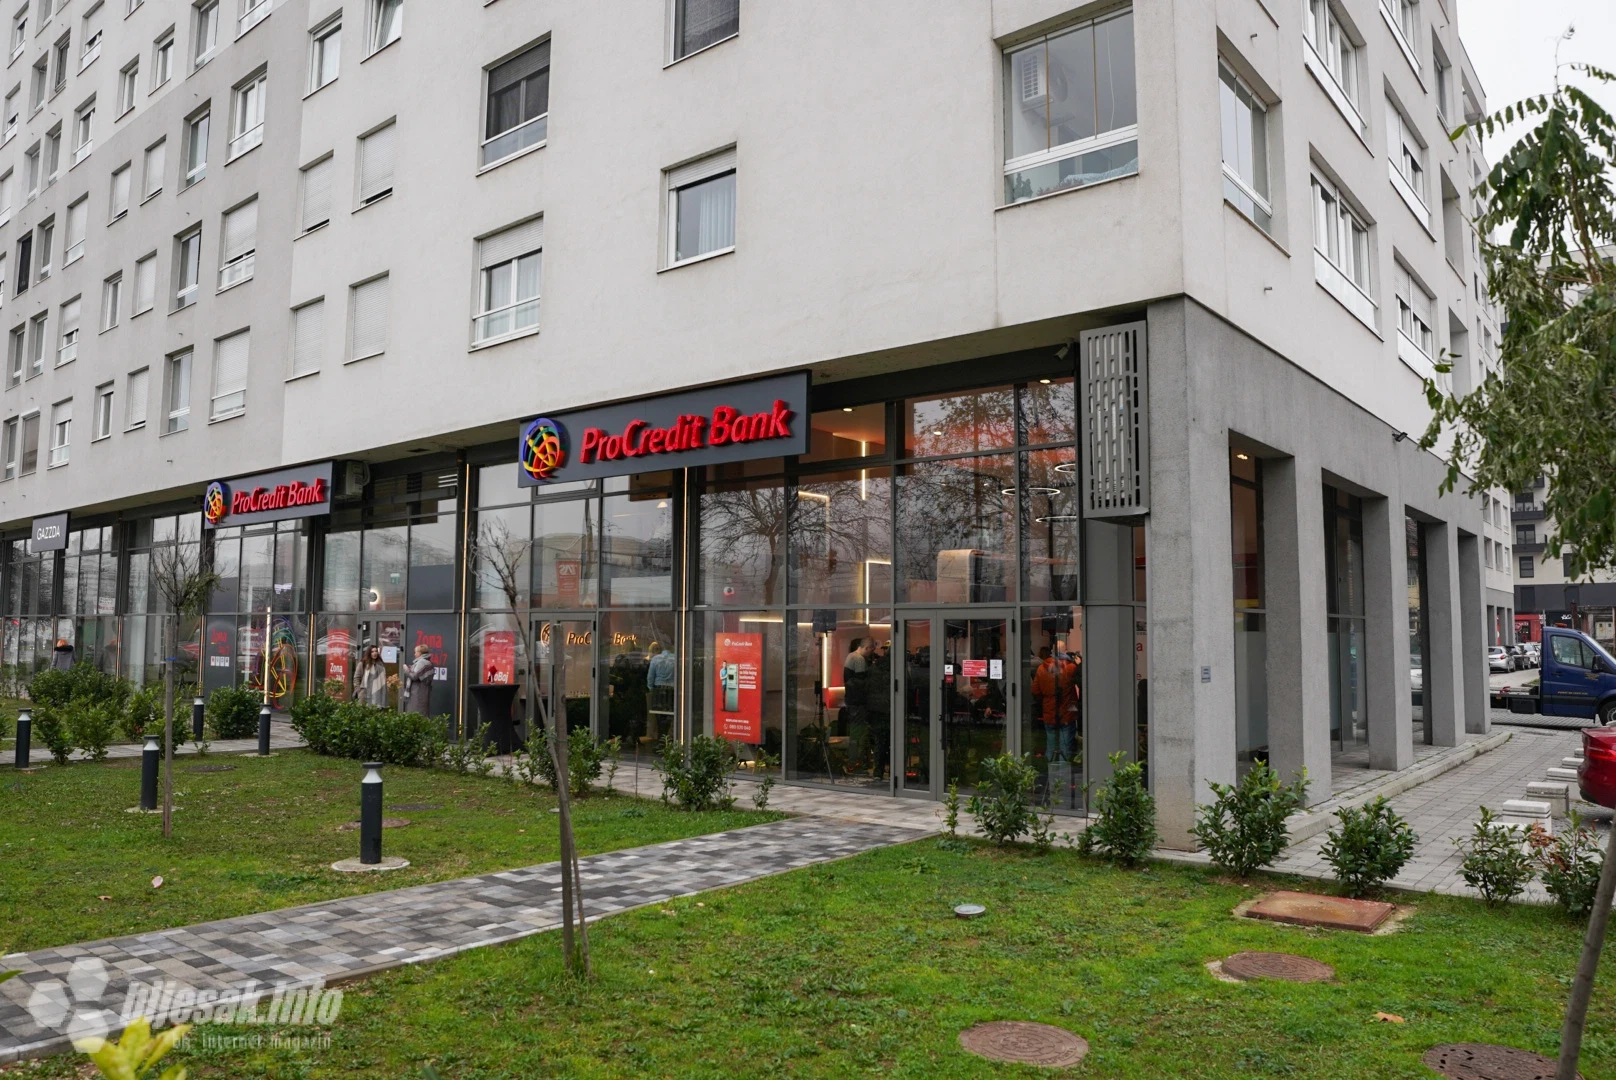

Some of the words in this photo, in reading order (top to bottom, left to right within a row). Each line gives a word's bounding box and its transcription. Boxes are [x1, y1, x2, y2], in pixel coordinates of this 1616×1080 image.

[579, 412, 706, 464] ProCredit
[708, 399, 793, 447] Bank
[231, 485, 289, 515] ProCredit
[287, 478, 327, 506] Bank
[36, 525, 61, 541] GAZZDA
[416, 629, 443, 649] Zona
[330, 662, 343, 673] Zona
